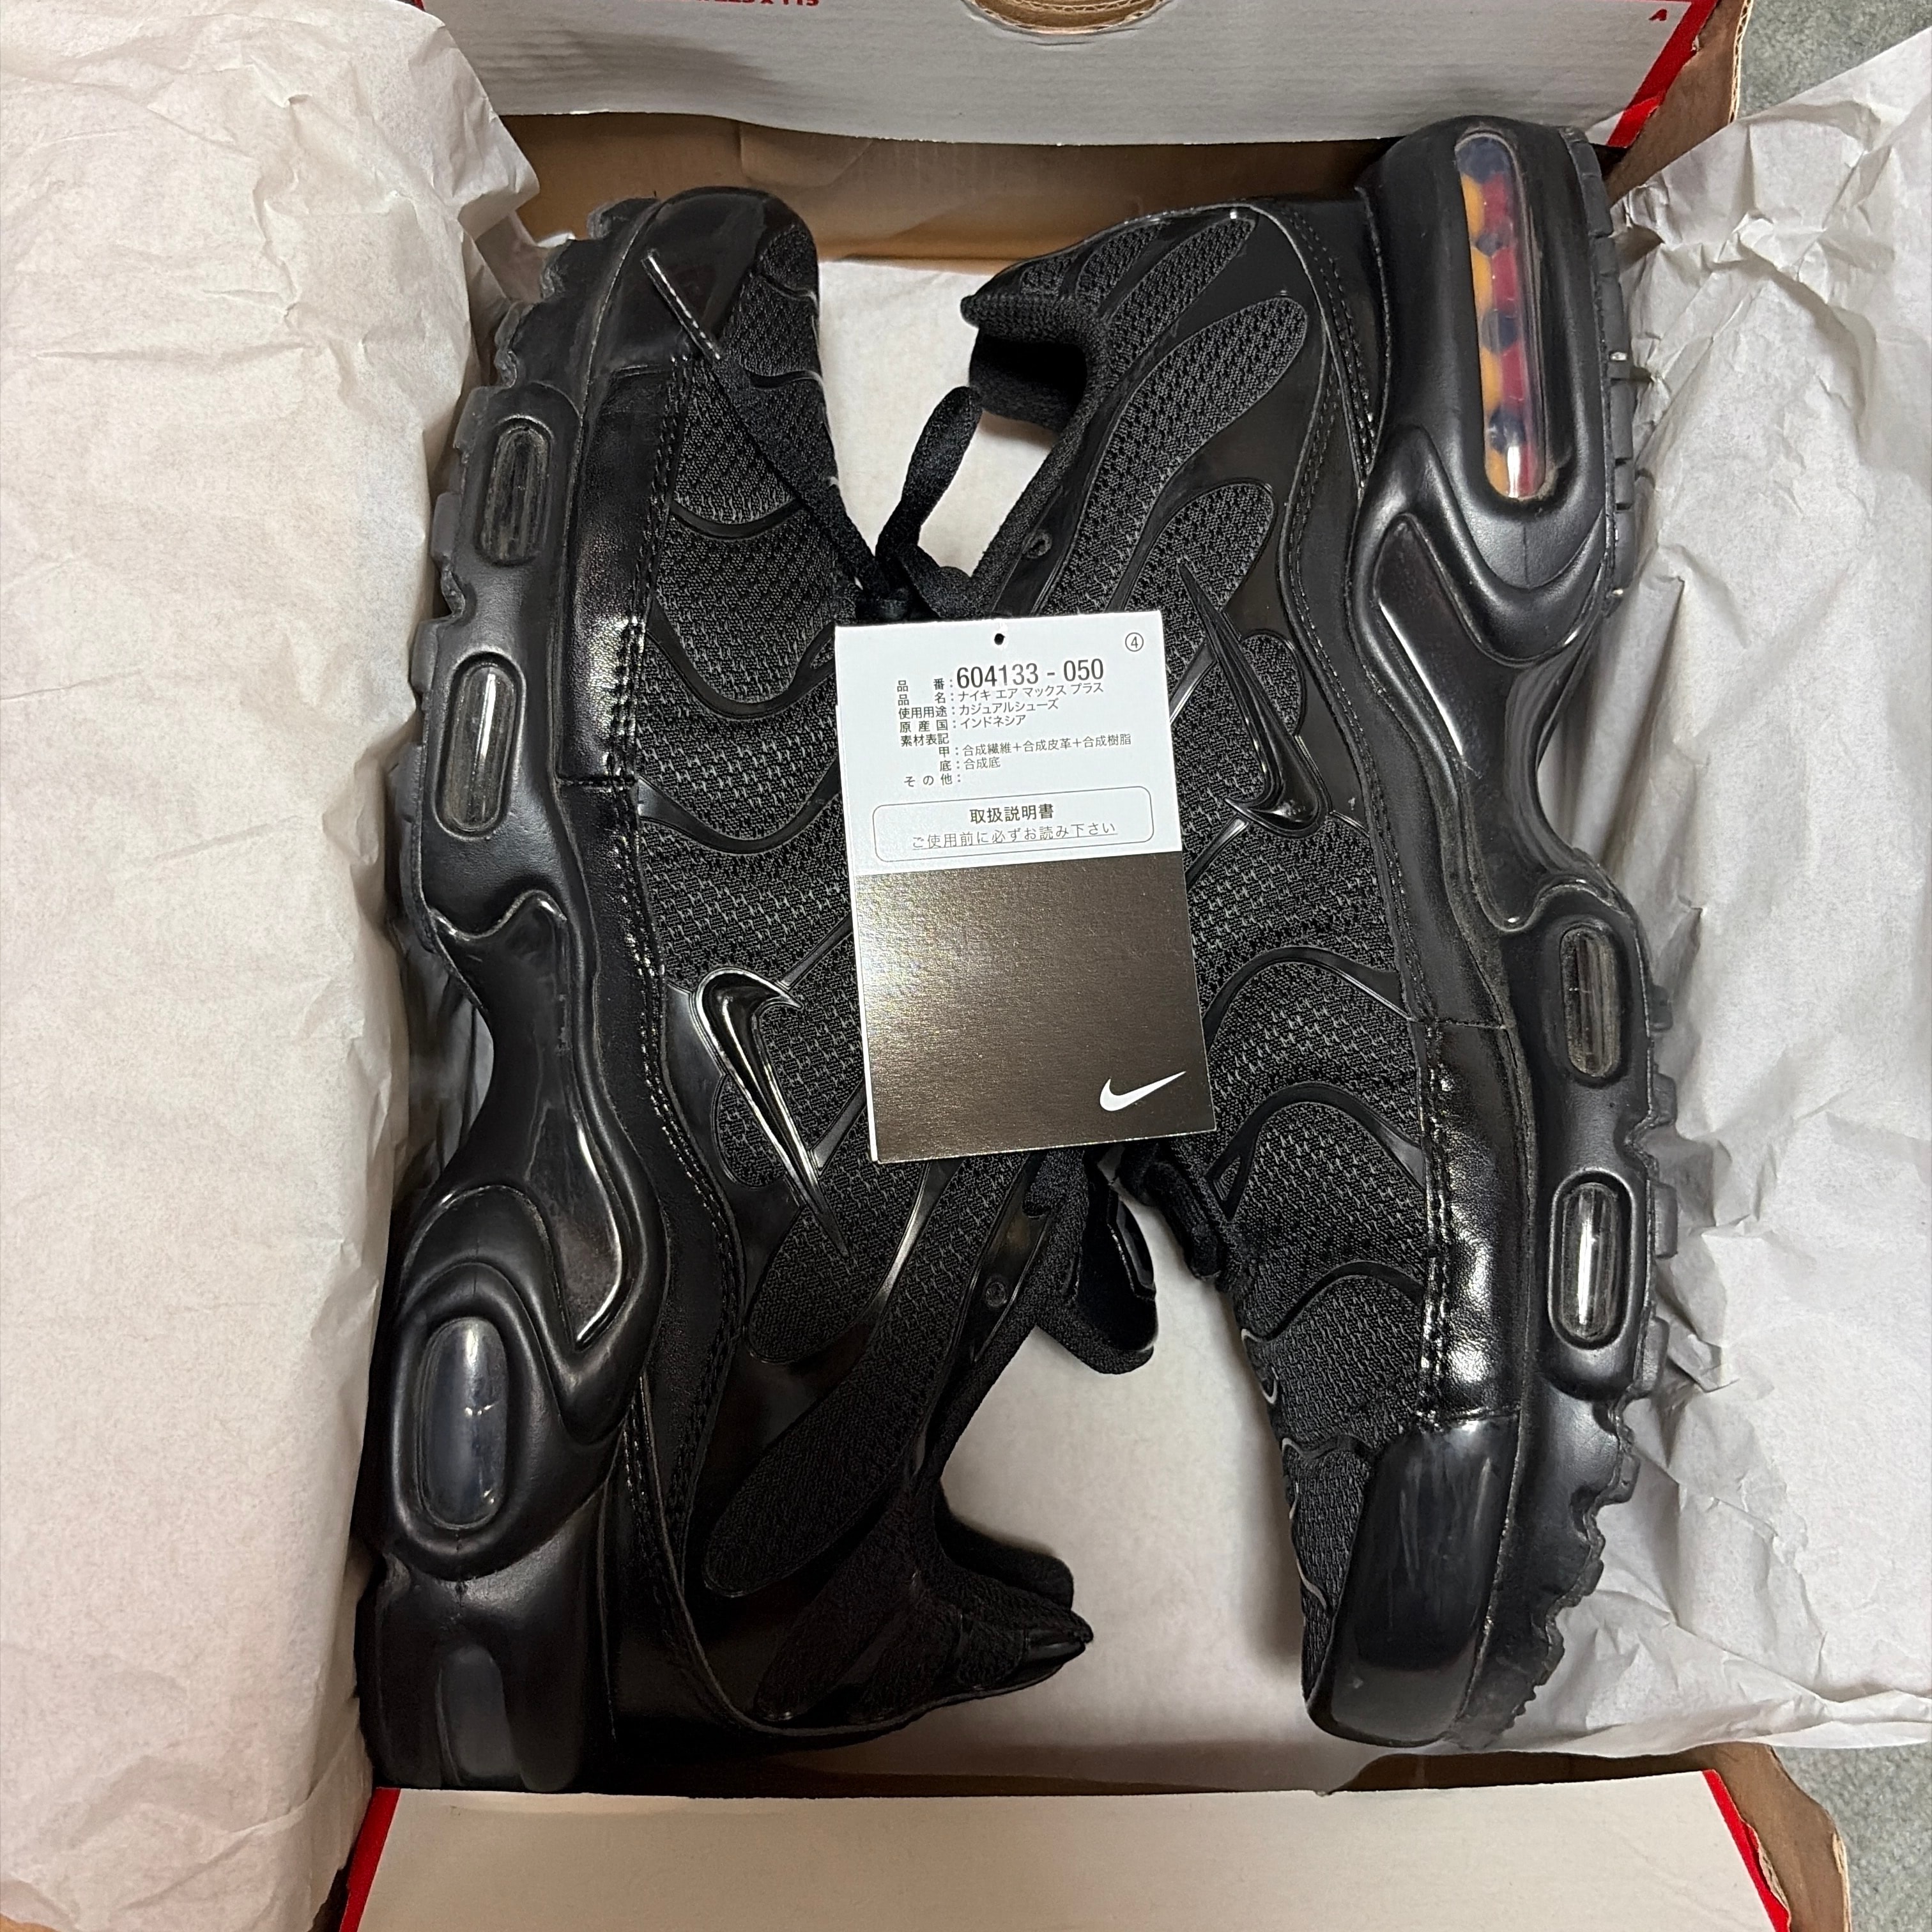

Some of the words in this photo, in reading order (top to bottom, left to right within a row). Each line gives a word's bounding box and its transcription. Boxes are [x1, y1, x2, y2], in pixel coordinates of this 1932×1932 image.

[900, 733, 950, 747] 素材表記
[969, 803, 1055, 825] 取扱説明書
[912, 822, 1116, 850] ご使用前に必ずお読み下さい
